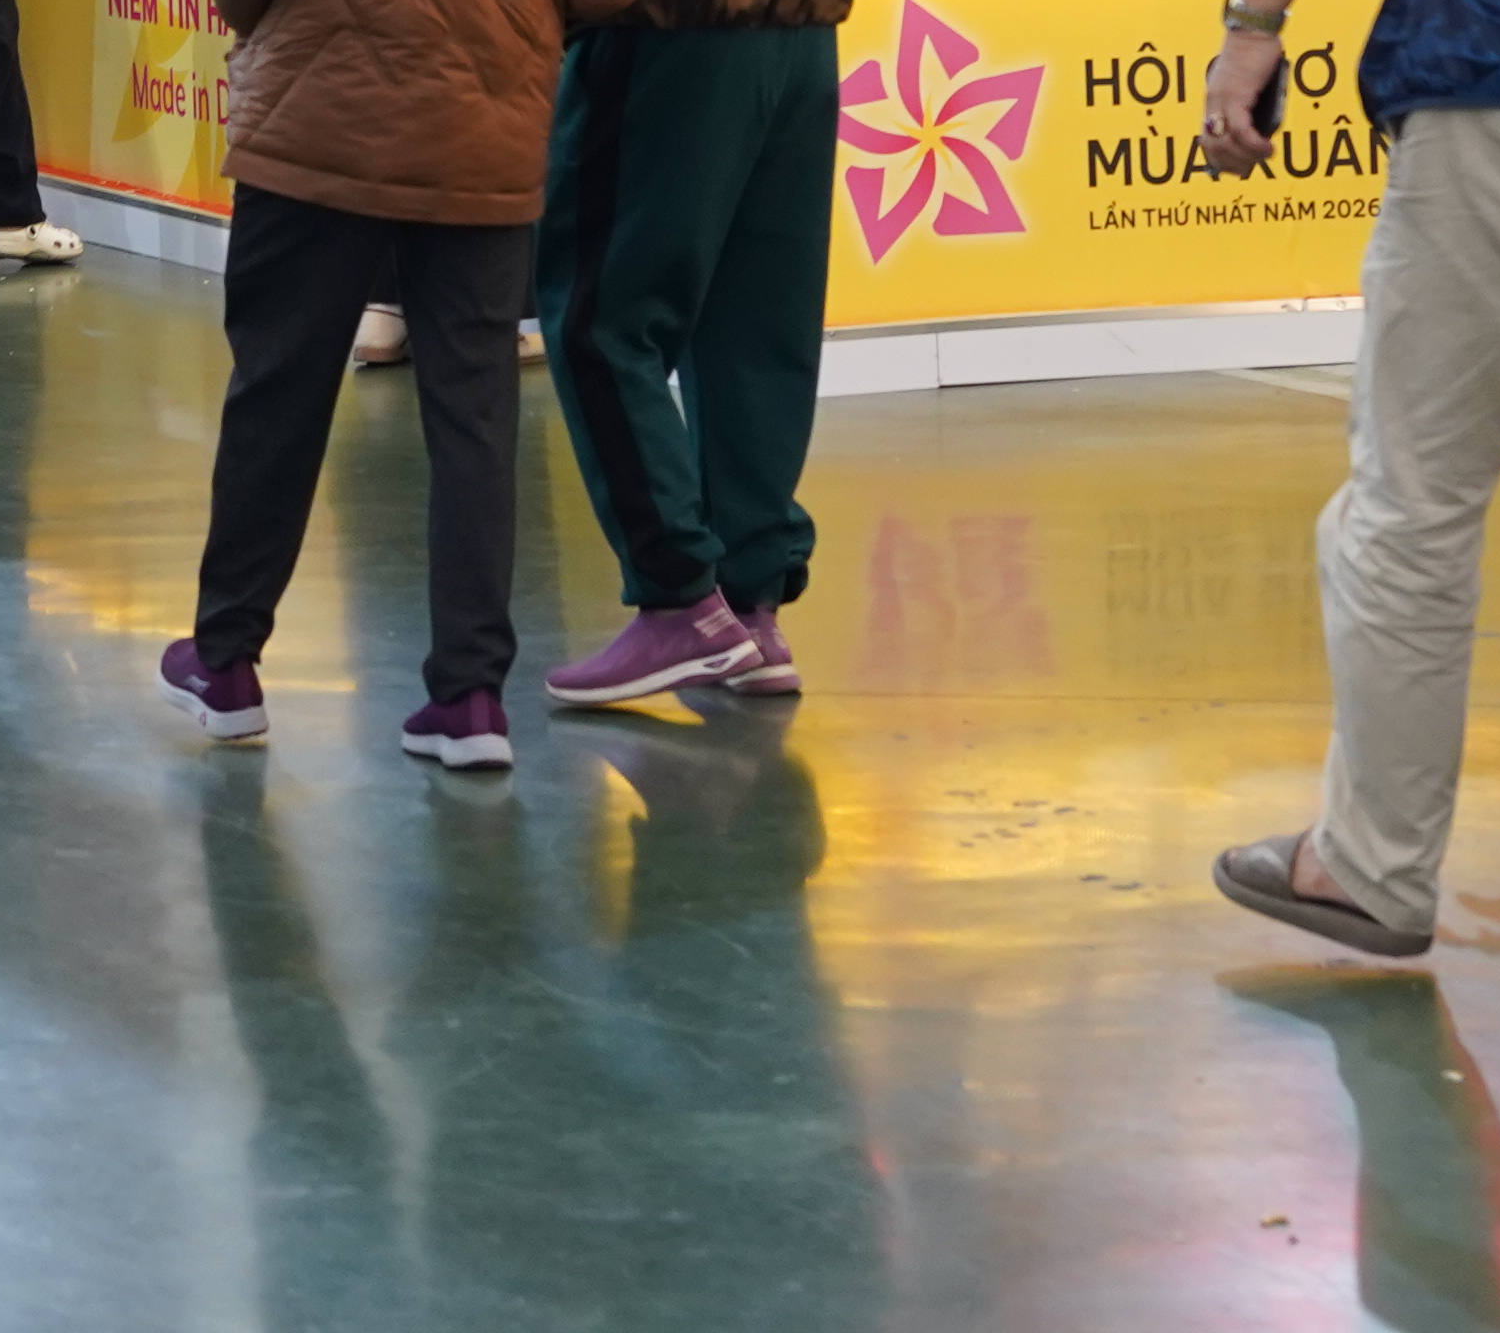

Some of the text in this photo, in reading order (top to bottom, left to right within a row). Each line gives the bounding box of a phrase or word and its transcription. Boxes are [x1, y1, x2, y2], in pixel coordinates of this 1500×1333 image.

[132, 61, 186, 117] Made
[192, 72, 210, 123] in
[1085, 41, 1186, 117] HỘI
[1088, 114, 1391, 188] MÙA UÂN
[1142, 200, 1191, 228] THỨ
[1195, 194, 1257, 226] NHẤT
[1264, 196, 1317, 221] NĂM
[1322, 197, 1380, 220] 2026
